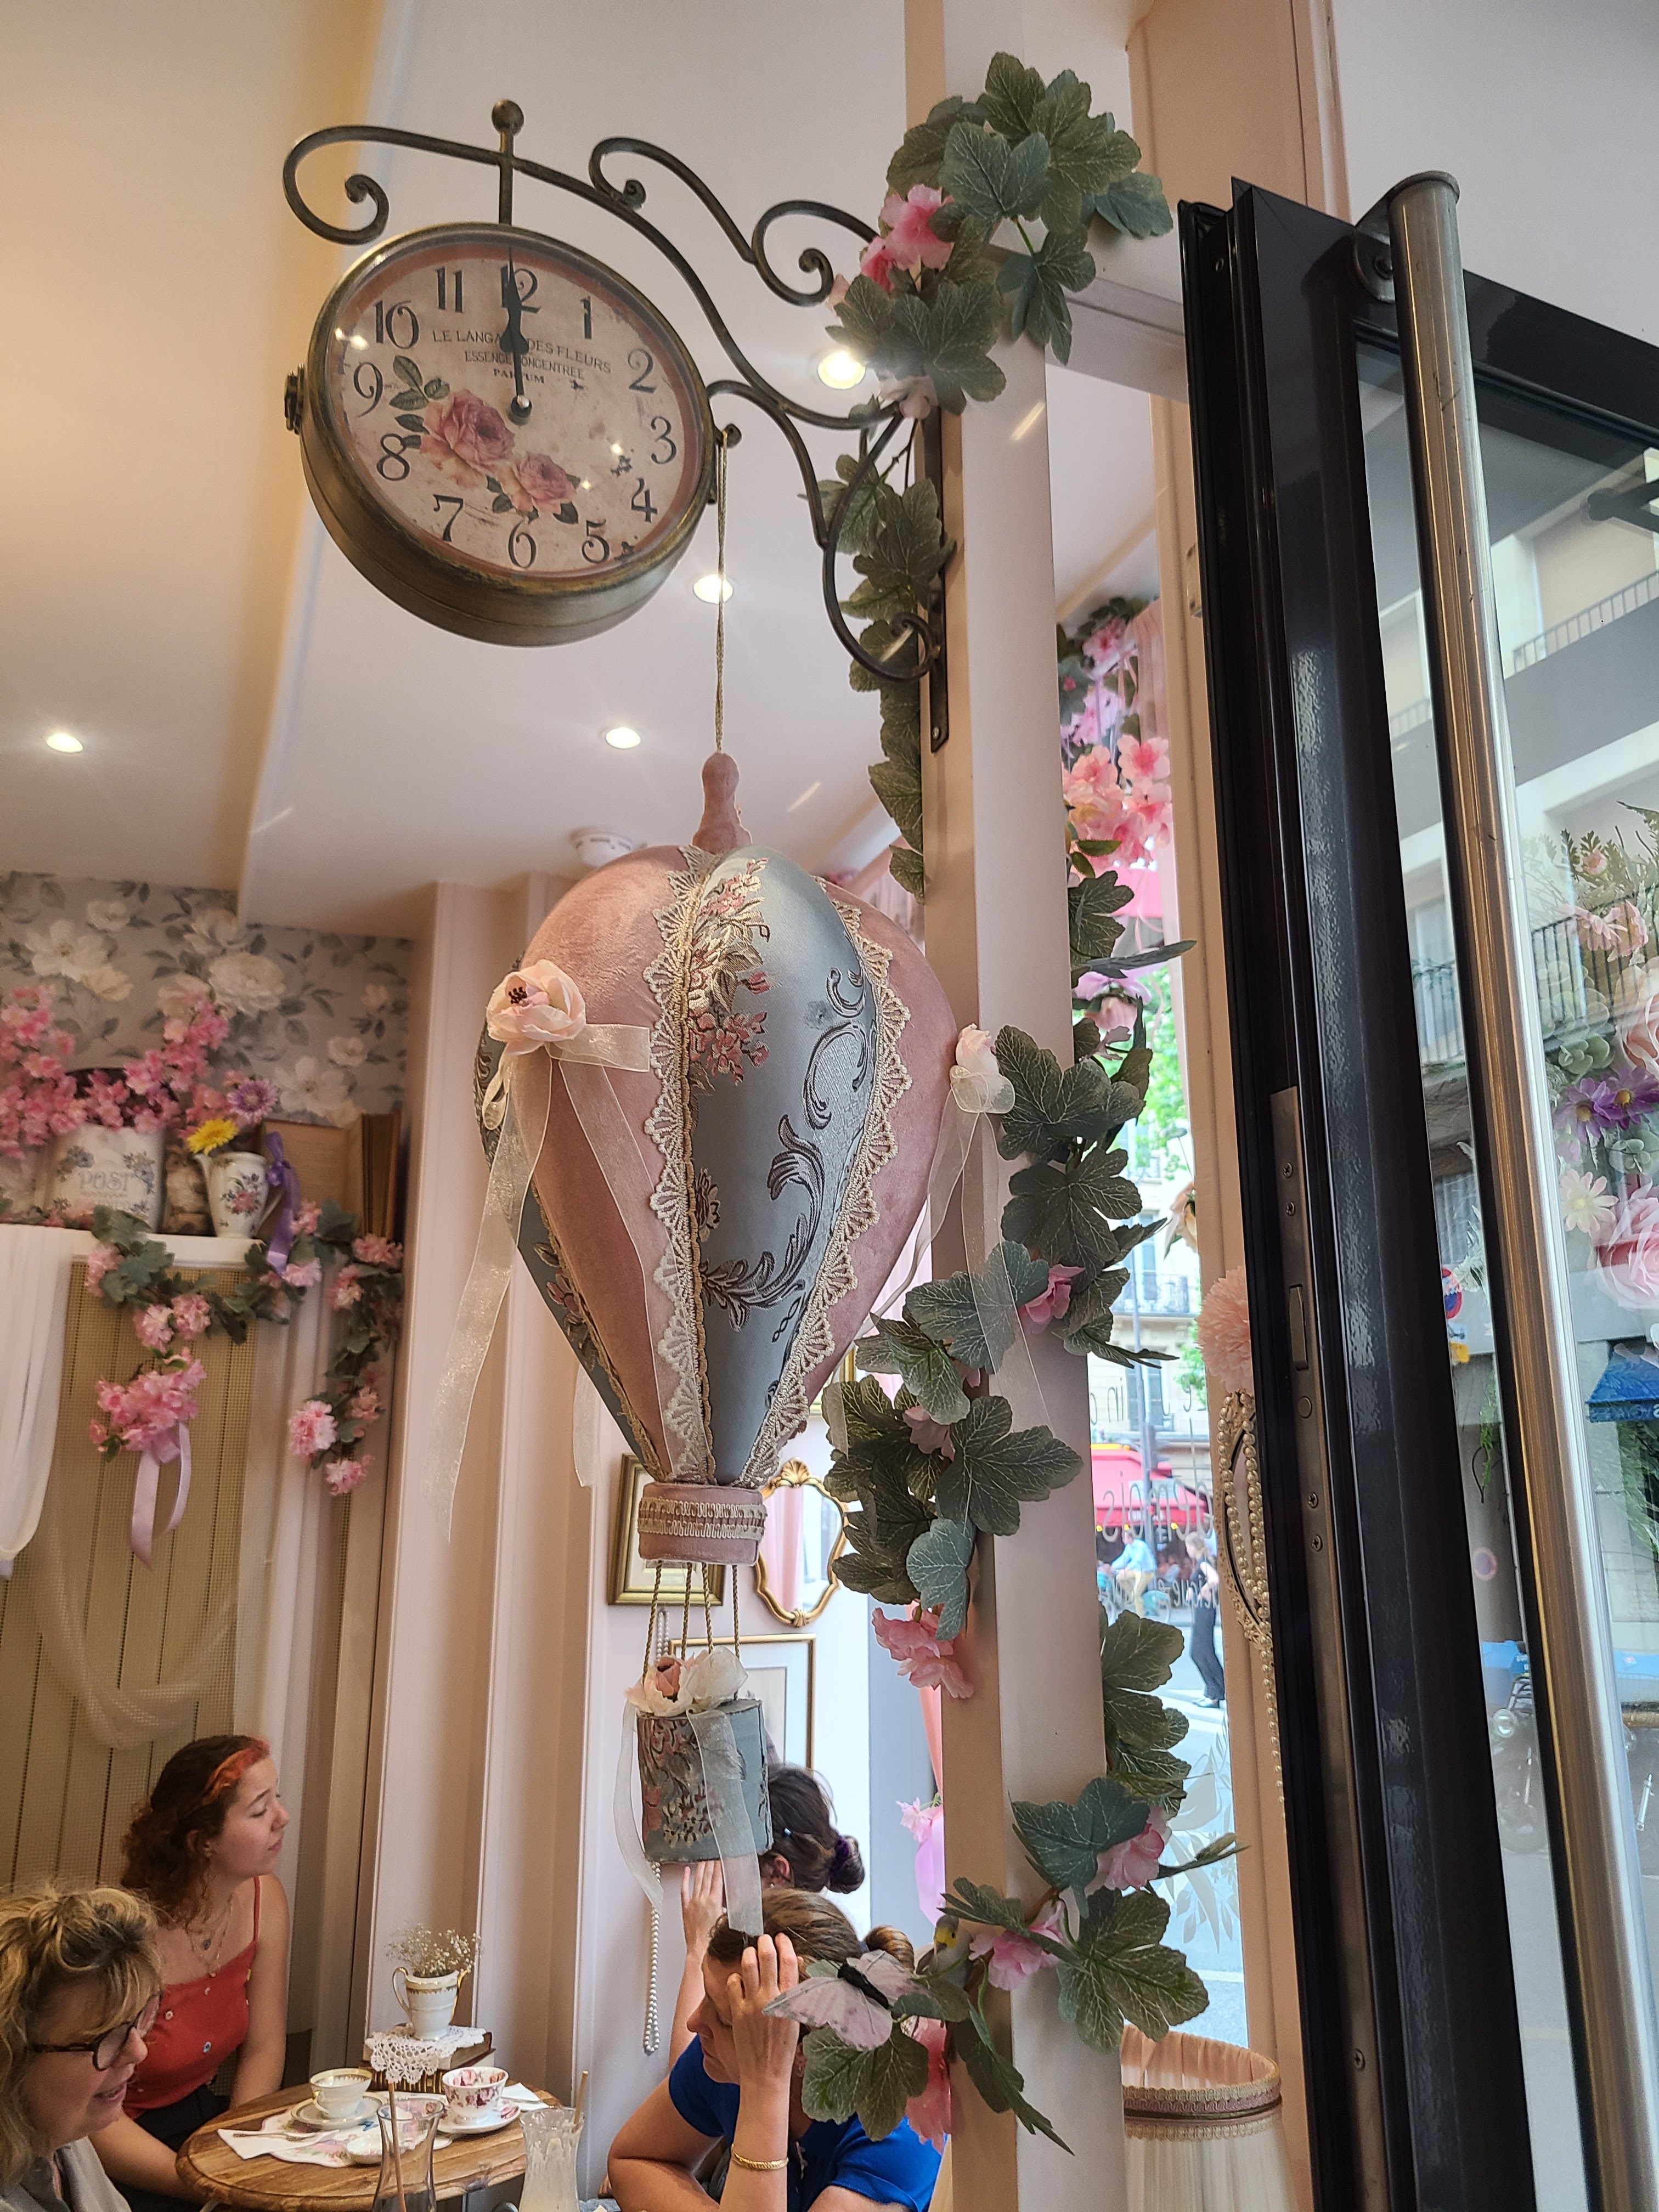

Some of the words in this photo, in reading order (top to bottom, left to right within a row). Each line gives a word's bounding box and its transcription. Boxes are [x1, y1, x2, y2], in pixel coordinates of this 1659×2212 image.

[436, 267, 462, 313] 11
[500, 264, 541, 314] 12
[375, 300, 419, 349] 10
[580, 296, 592, 340] 1
[433, 330, 452, 342] LE
[557, 346, 611, 374] FLEURS
[521, 356, 585, 381] ONCENTREE
[628, 348, 657, 394] 2
[353, 362, 383, 418] 9
[376, 433, 410, 481] 8
[651, 416, 677, 465] 3
[433, 494, 464, 542] 7
[631, 478, 658, 523] 4
[508, 521, 537, 568] 6
[582, 518, 610, 564] 5
